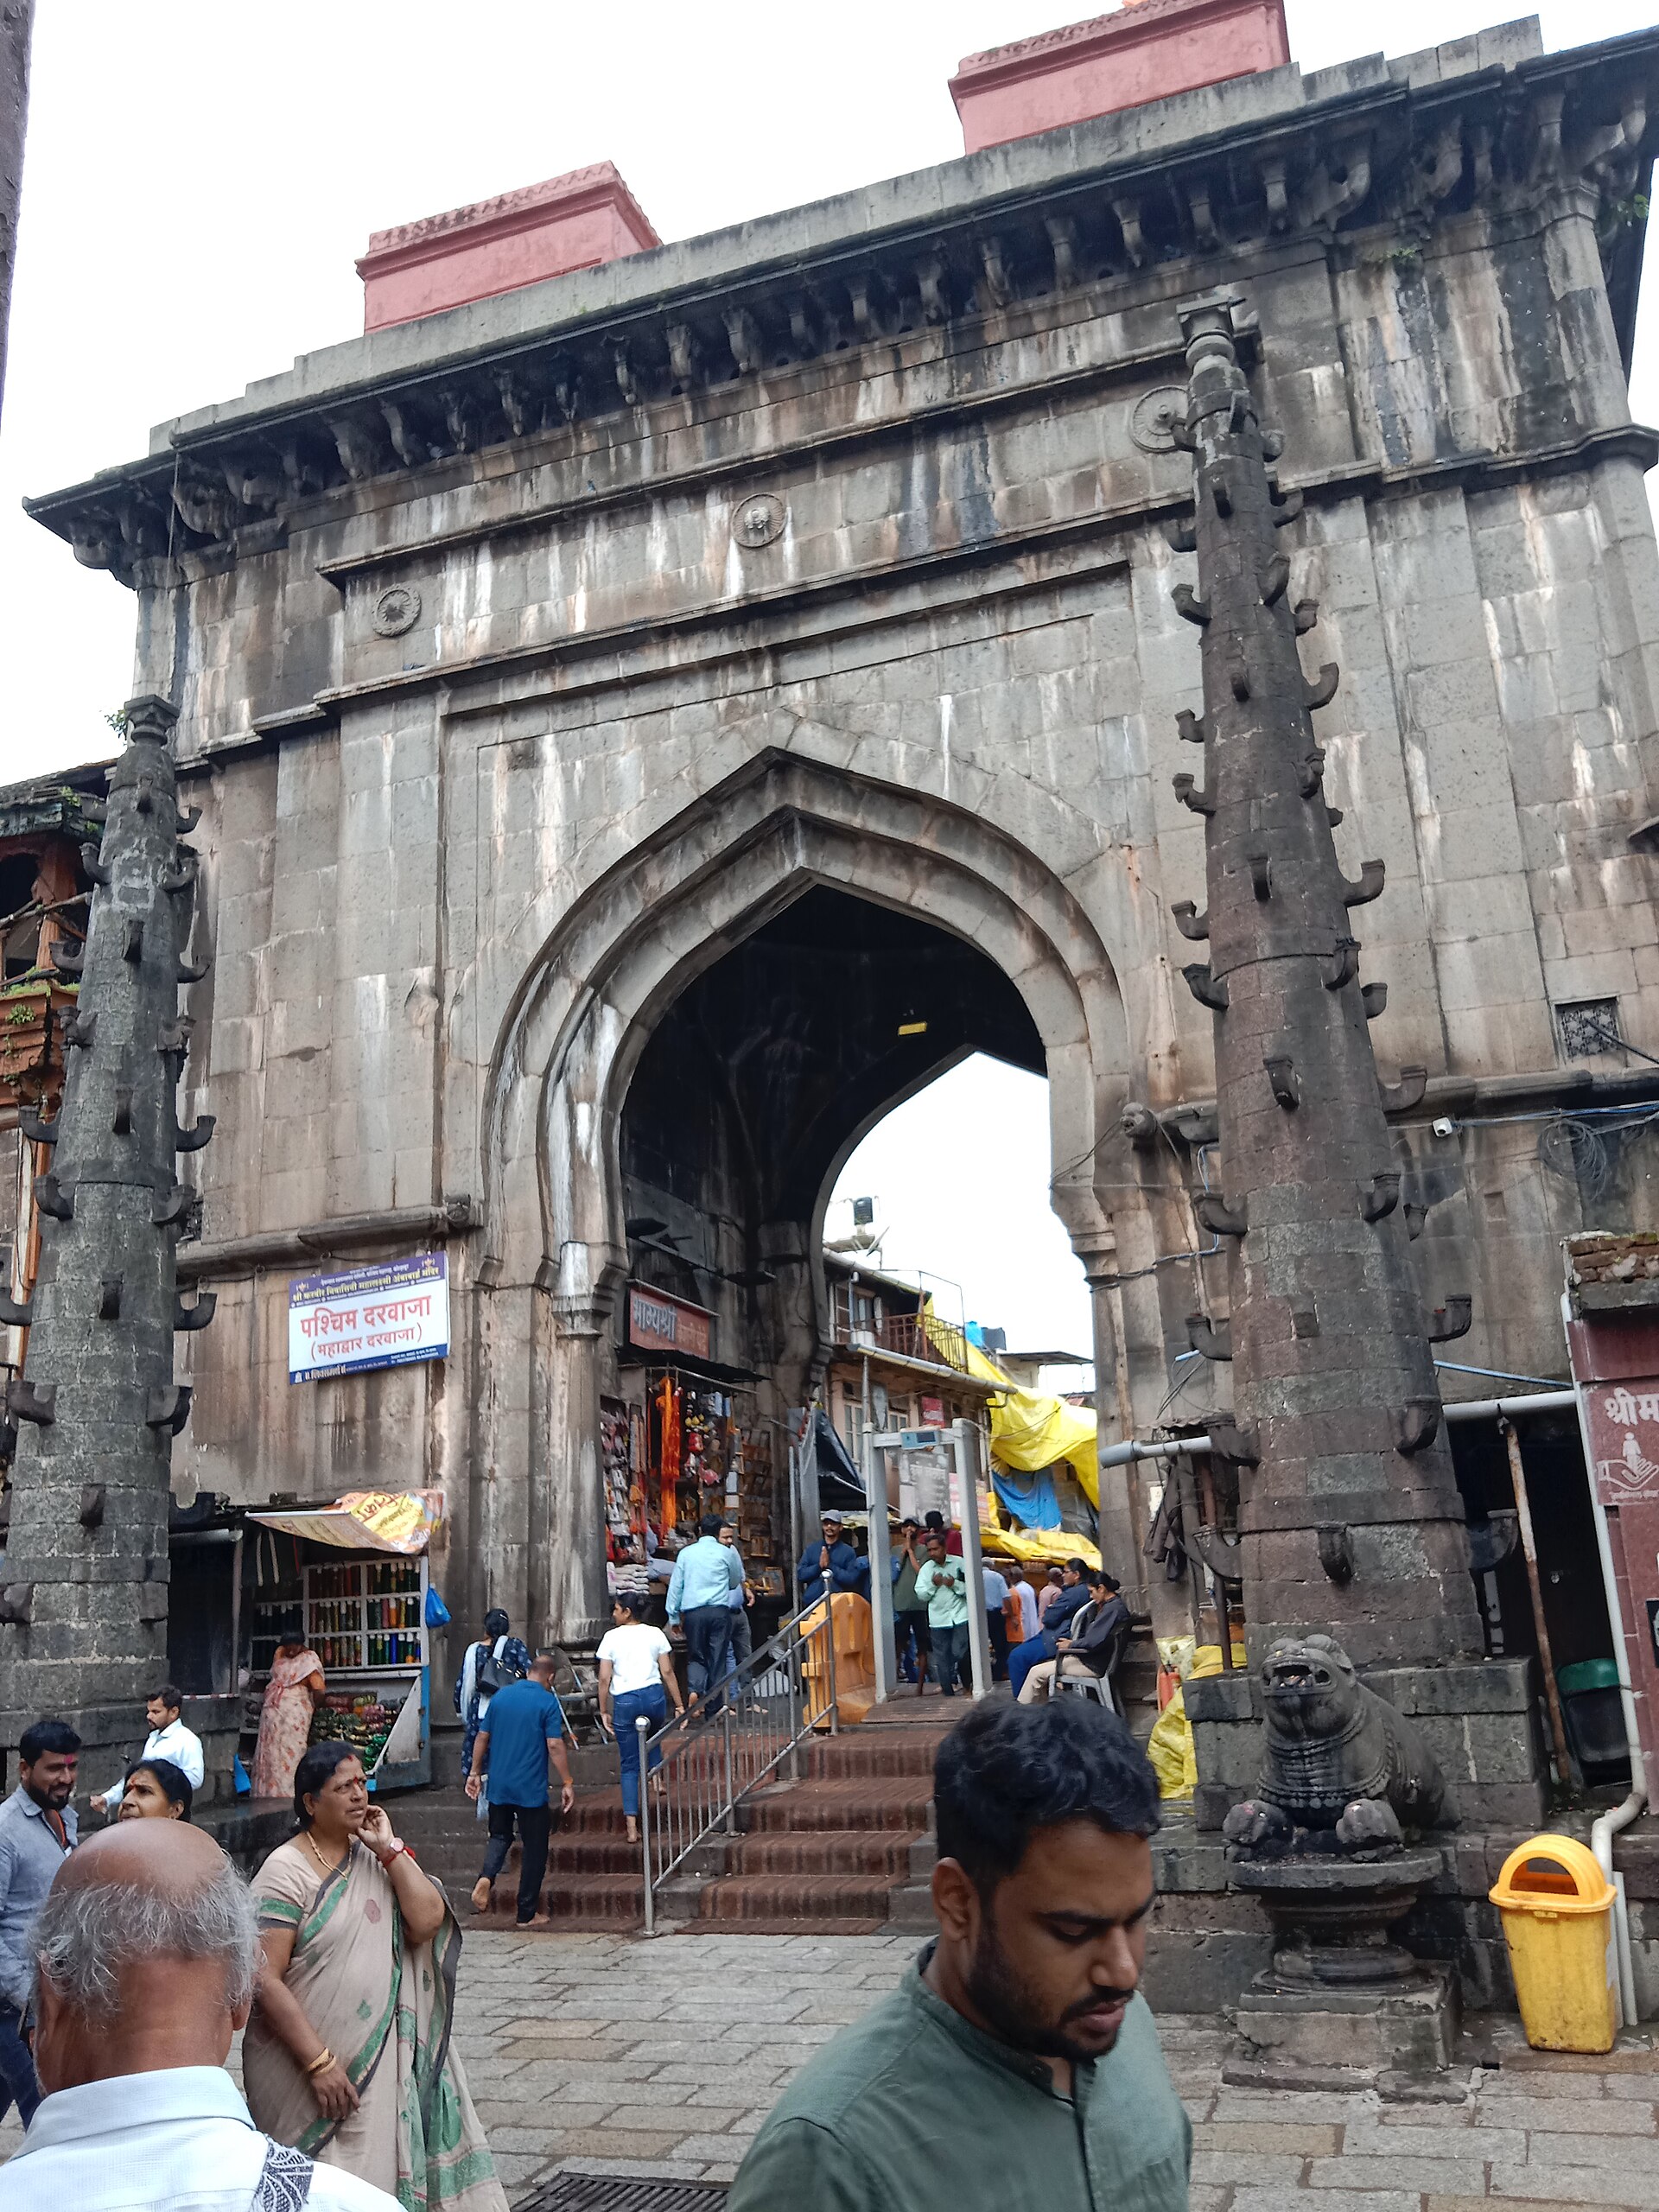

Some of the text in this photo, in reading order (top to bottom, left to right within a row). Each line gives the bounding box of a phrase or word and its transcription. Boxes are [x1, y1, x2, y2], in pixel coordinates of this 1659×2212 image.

[301, 1295, 432, 1338] पश्चिम दरवाजा
[310, 1337, 363, 1363] (महाद्वार
[366, 1322, 423, 1348] दरवाजा)
